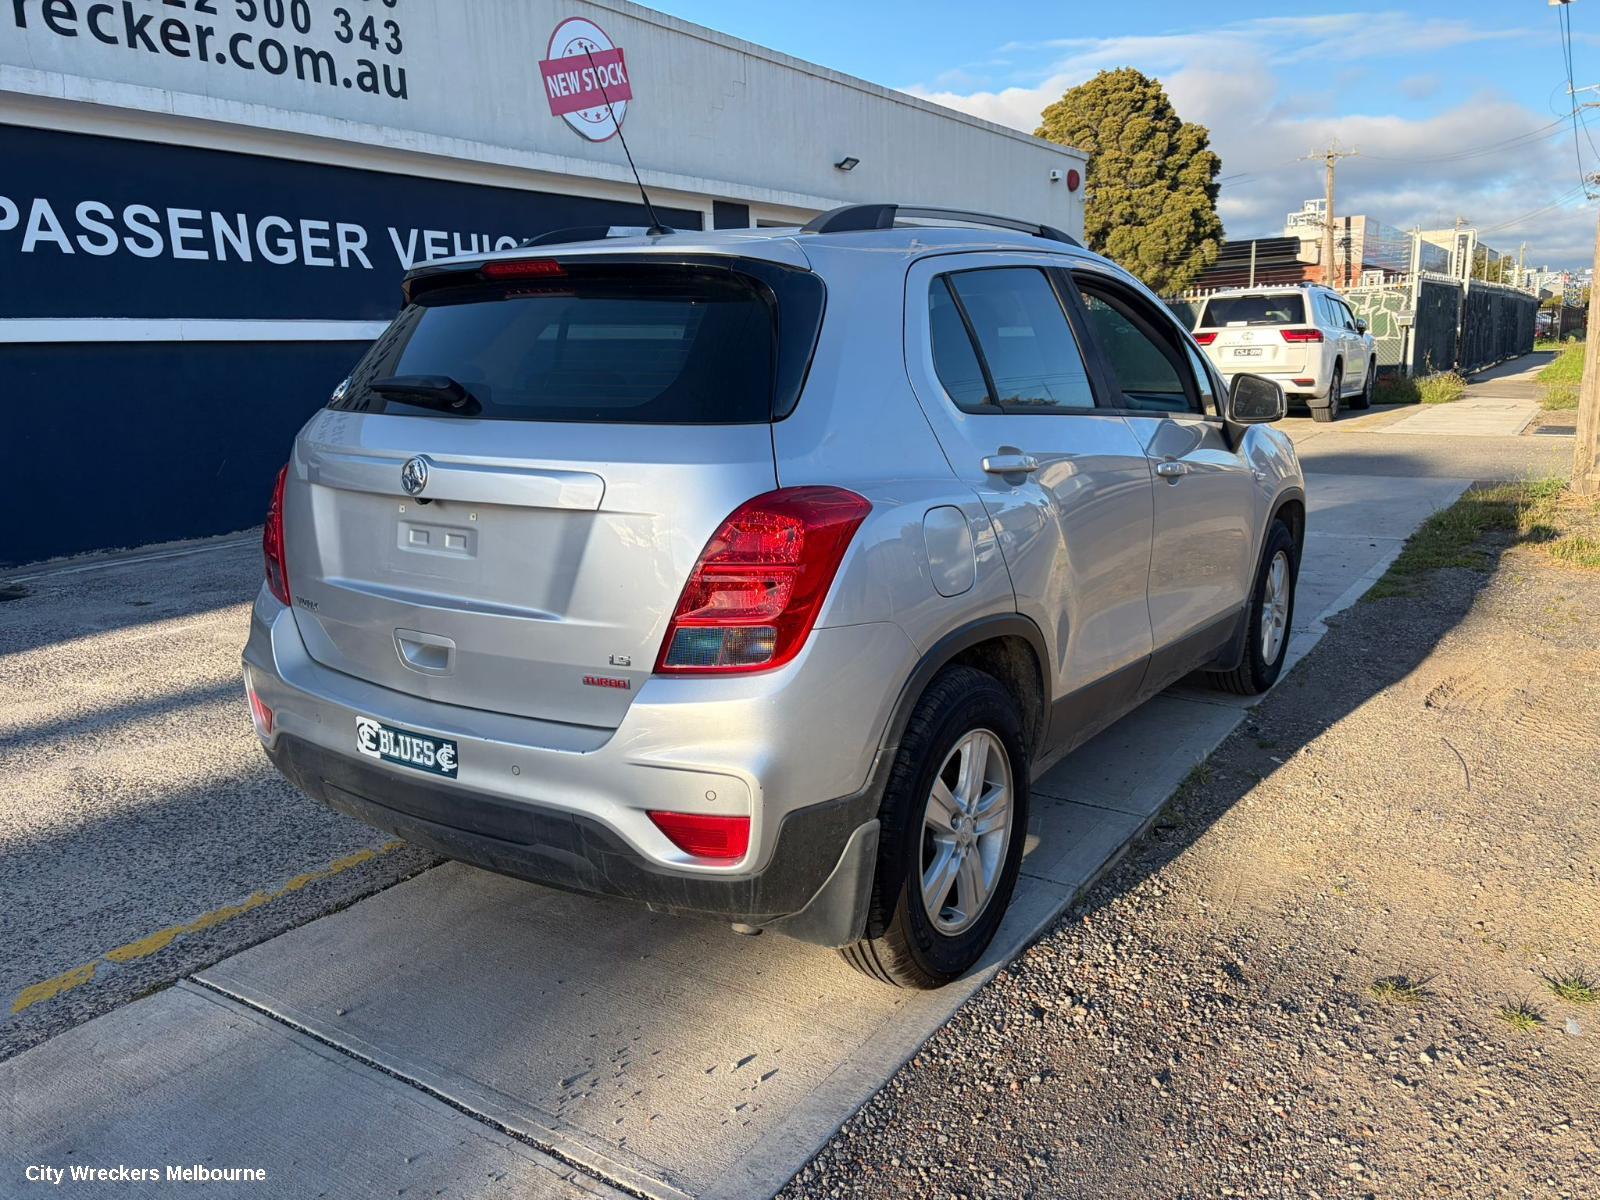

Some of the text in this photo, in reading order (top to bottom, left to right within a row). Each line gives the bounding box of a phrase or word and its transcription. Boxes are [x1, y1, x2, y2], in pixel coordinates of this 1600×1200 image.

[12, 0, 408, 100] recker.com.au
[333, 7, 403, 55] 343
[546, 62, 627, 99] NEW STOCK
[582, 675, 631, 690] TURBO
[378, 728, 435, 767] BLUES
